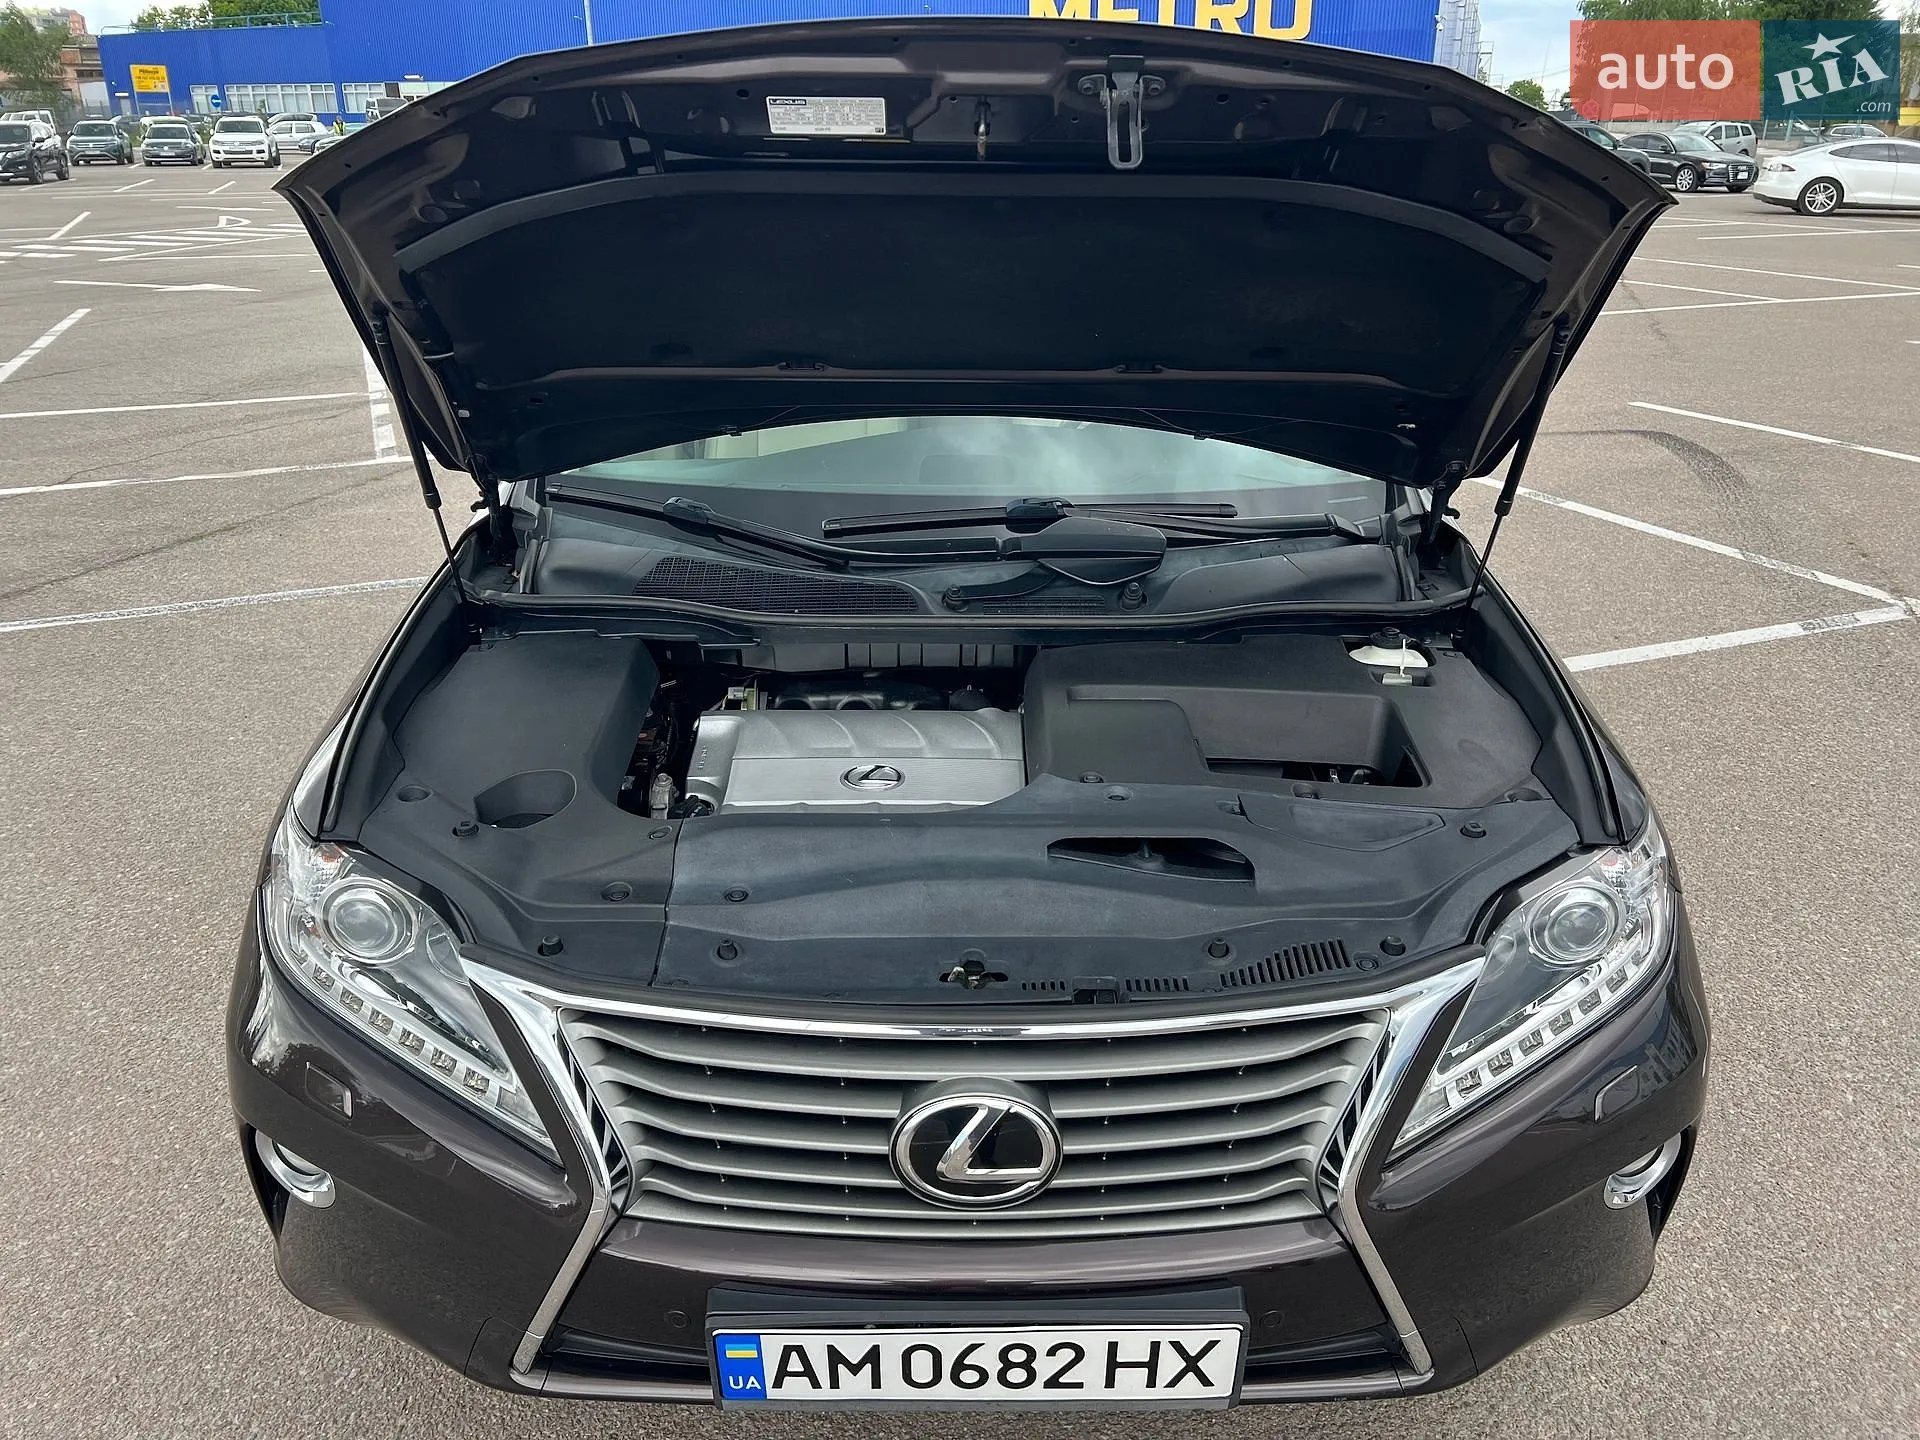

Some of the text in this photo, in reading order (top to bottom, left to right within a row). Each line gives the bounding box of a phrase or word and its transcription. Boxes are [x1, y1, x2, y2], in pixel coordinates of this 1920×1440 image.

[771, 1339, 1221, 1390] AM 0682 HX
[729, 1375, 761, 1391] UA
